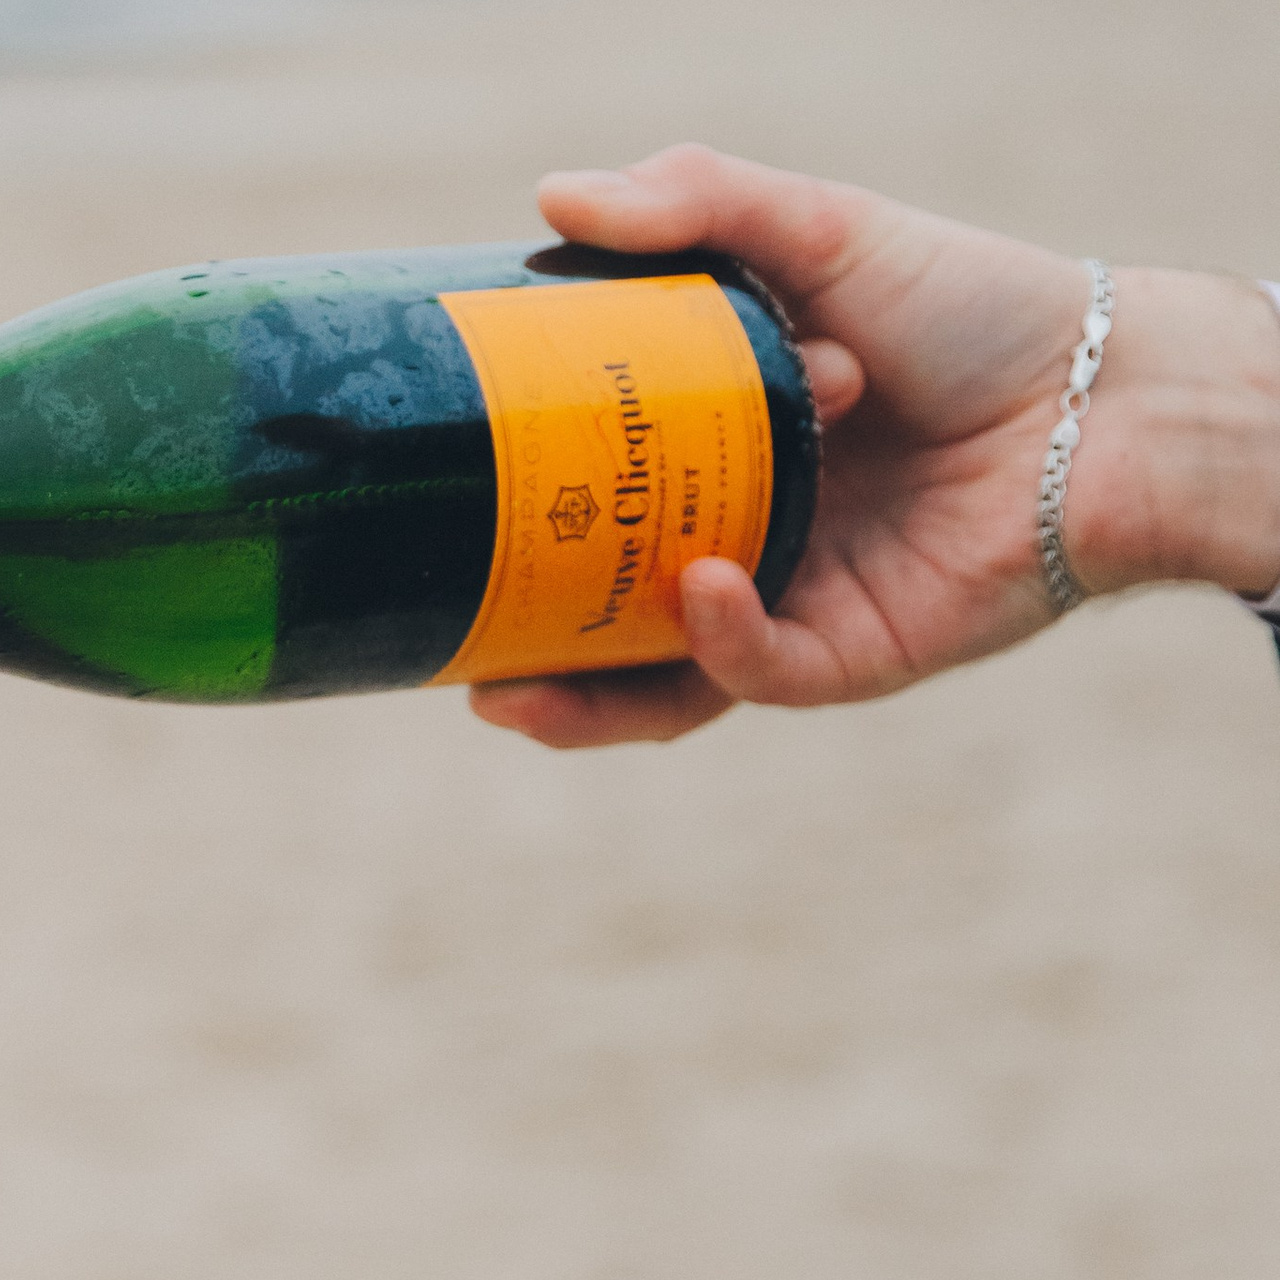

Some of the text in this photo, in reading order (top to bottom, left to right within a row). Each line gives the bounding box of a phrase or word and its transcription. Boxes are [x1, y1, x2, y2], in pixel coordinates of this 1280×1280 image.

[580, 362, 653, 634] Veuve Clicquot
[682, 469, 700, 536] BRUT
